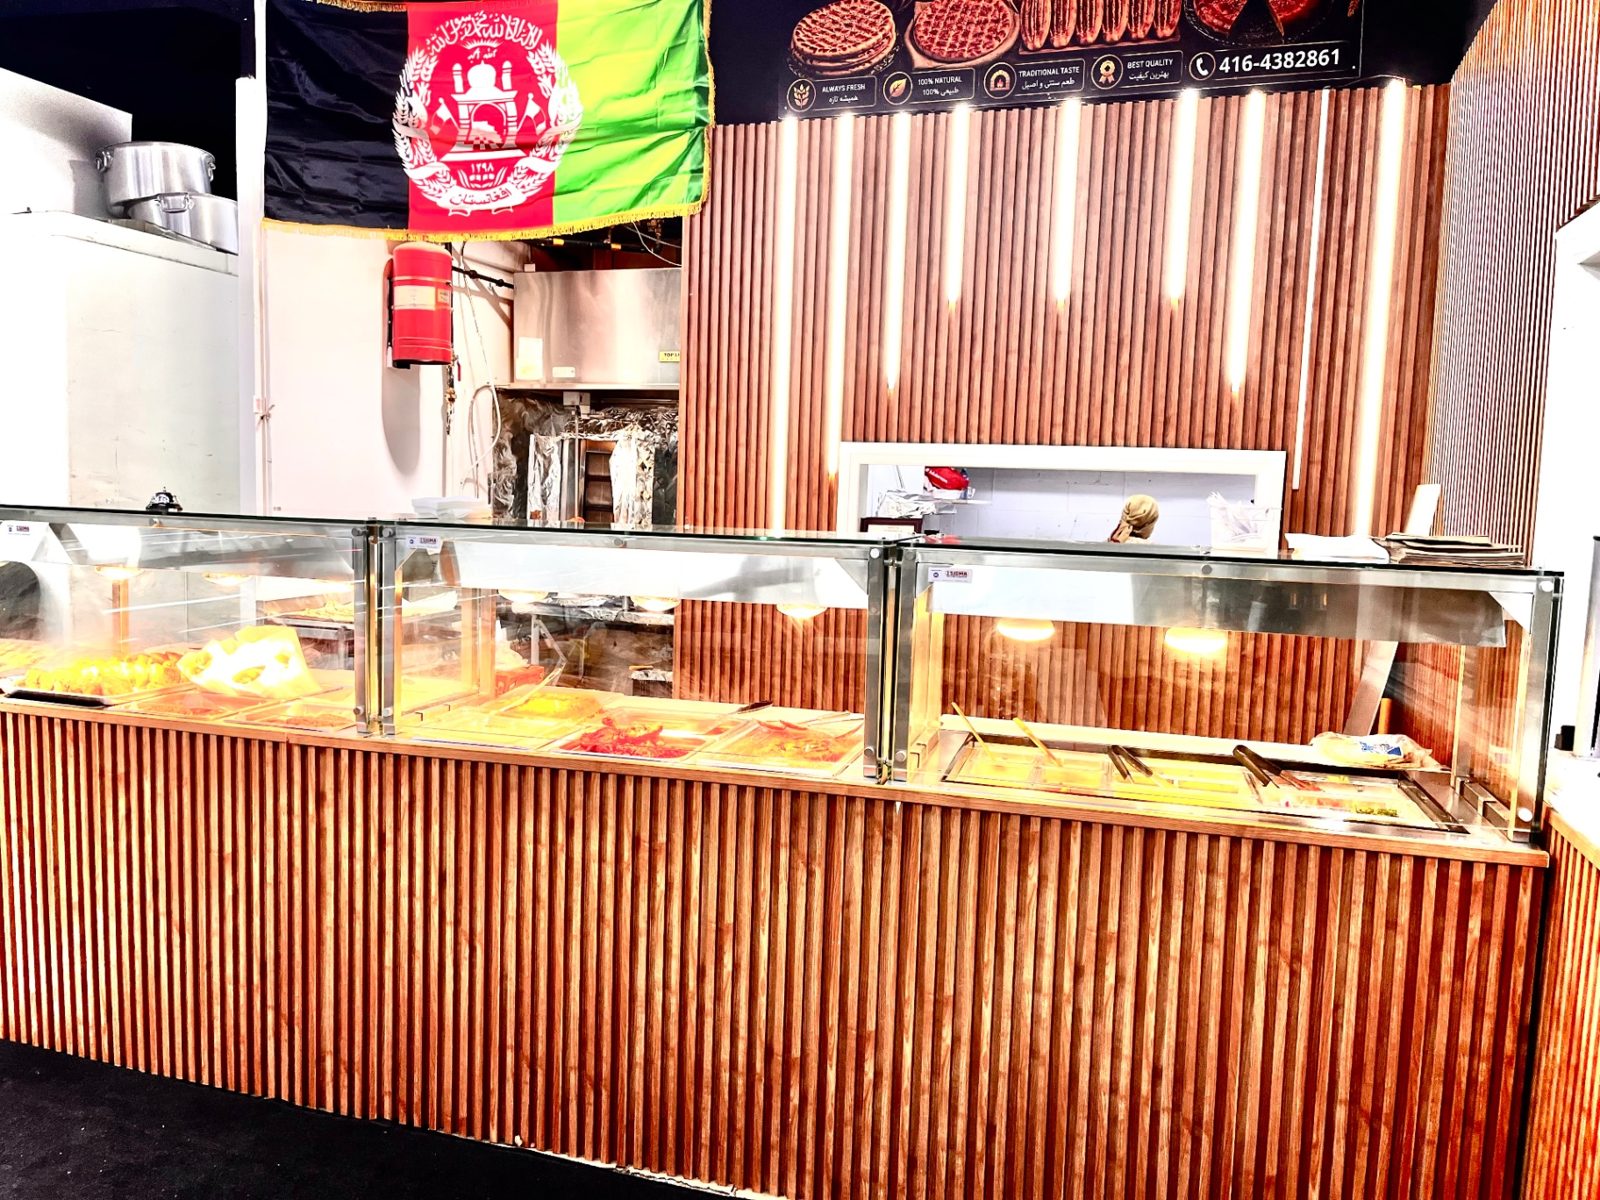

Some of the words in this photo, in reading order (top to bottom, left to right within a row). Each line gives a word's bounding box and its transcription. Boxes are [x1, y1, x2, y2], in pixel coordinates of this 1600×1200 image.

[1127, 60, 1144, 69] BEST
[1145, 58, 1174, 68] QUALITY
[1219, 48, 1340, 73] 416-4382861
[1018, 68, 1059, 77] TRADITIONAL
[1060, 66, 1080, 74] TASTE
[918, 78, 934, 86] 100%
[934, 76, 963, 84] NATURAL
[822, 85, 846, 93] ALWAYS
[846, 83, 866, 91] FRESH
[922, 88, 940, 96] 100%
